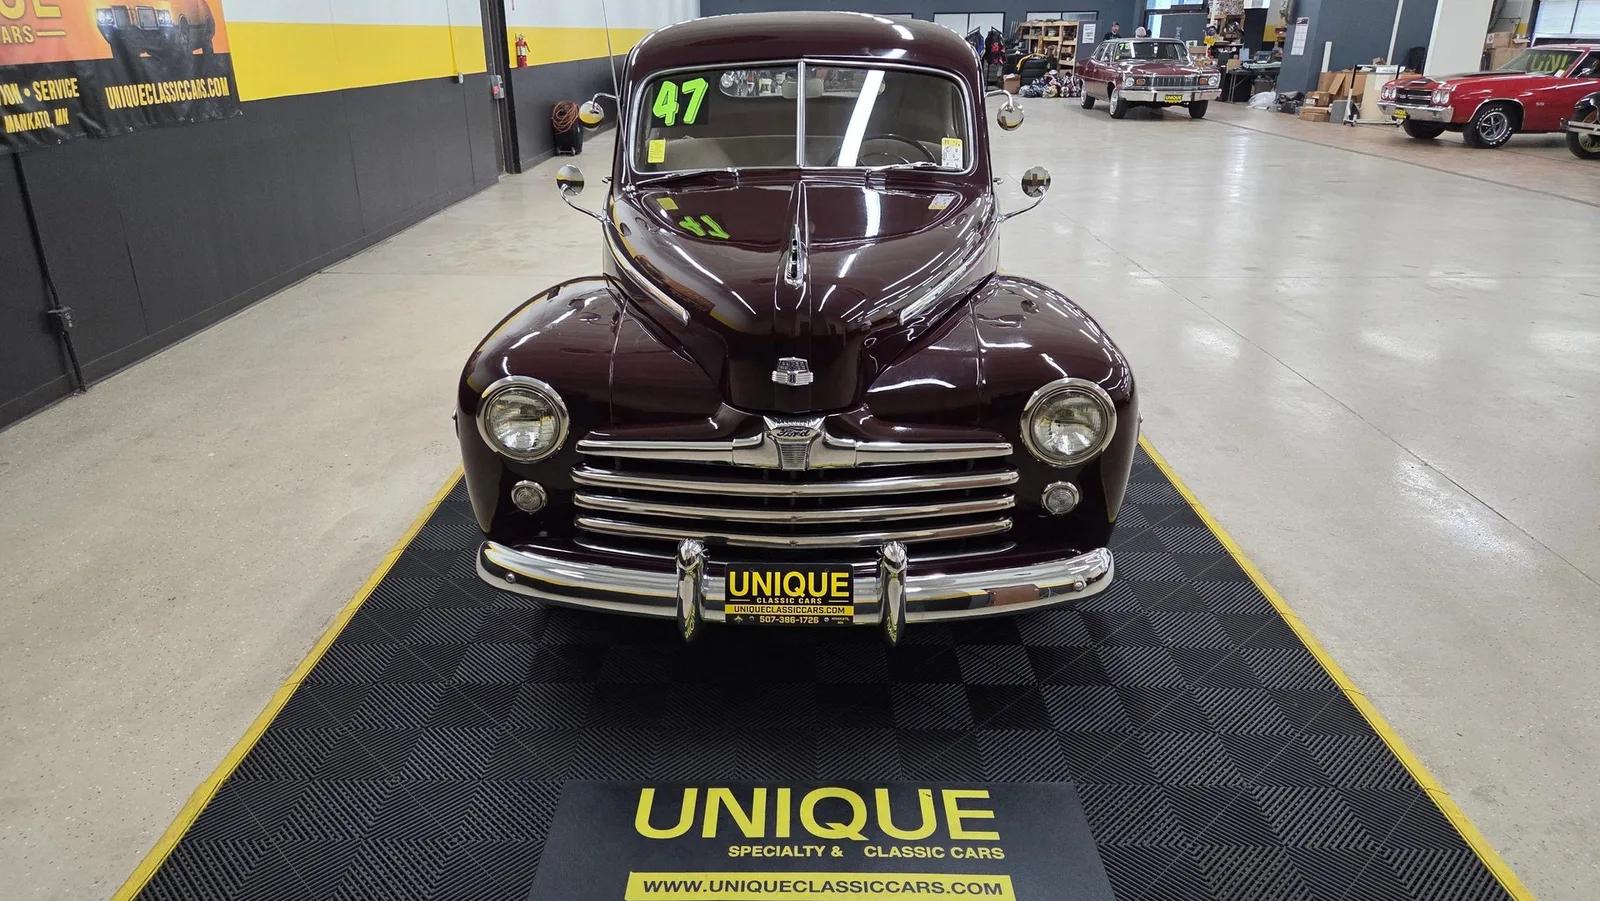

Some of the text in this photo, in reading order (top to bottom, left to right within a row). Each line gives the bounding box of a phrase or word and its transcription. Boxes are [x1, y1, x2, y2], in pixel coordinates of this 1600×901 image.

[32, 78, 80, 102] SERVICE
[105, 77, 230, 109] UNIQUECLASSICCARS.COM
[652, 77, 709, 127] 47
[4, 108, 69, 134] MANKATO, MN
[776, 428, 812, 438] Ford
[729, 571, 850, 598] UNIQUE
[734, 605, 845, 615] UNIQUECLASSICCARS.COM
[798, 597, 822, 605] CARS
[634, 786, 1001, 841] UNIQUE
[728, 844, 1006, 860] SPECIALTY & CLASSIC CARS
[643, 879, 1003, 896] WWW.UNIQUECLASSICCARS.COM
